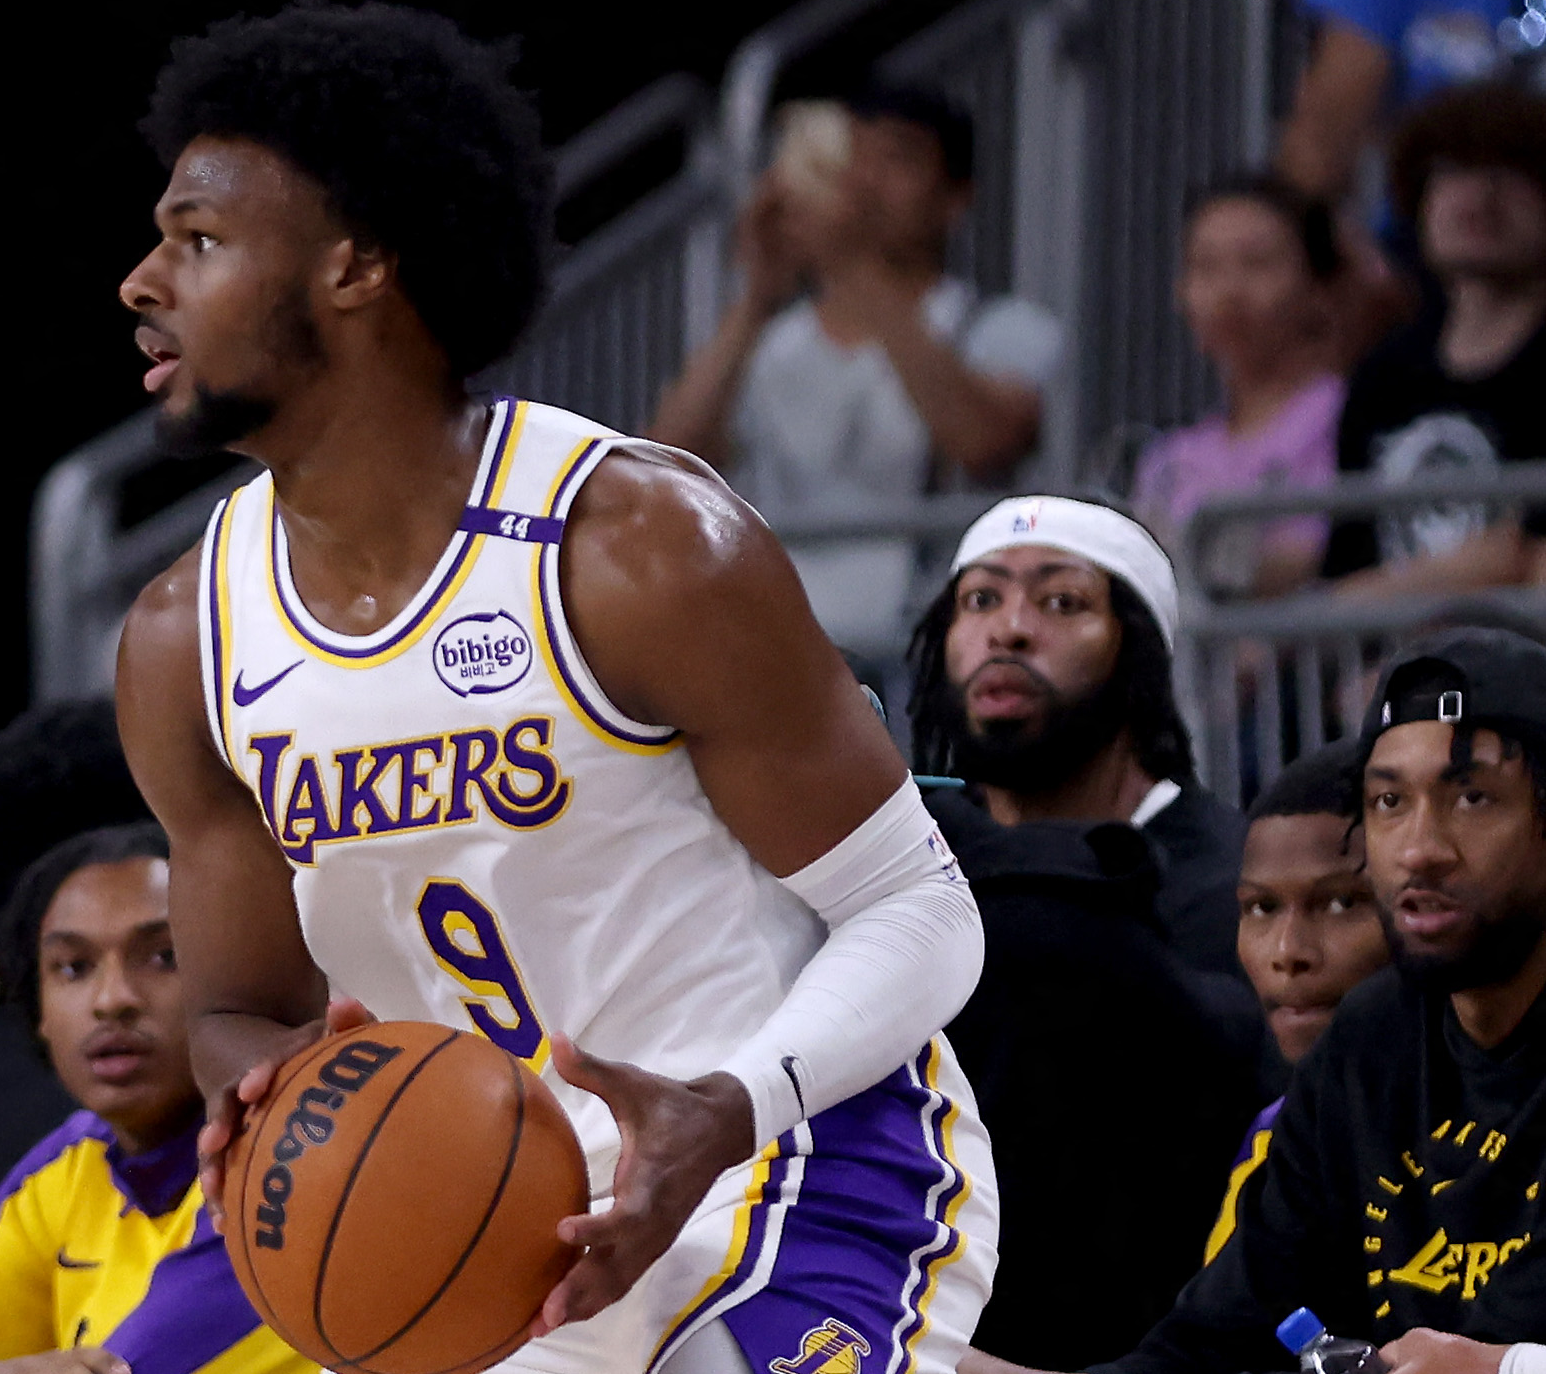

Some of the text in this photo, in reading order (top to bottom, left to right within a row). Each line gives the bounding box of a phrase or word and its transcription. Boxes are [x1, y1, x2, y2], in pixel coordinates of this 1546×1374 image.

[499, 514, 531, 539] 44
[441, 633, 527, 668] bibigo
[249, 716, 574, 869] LAKERS
[414, 876, 551, 1073] 9
[255, 1040, 405, 1251] Wilson
